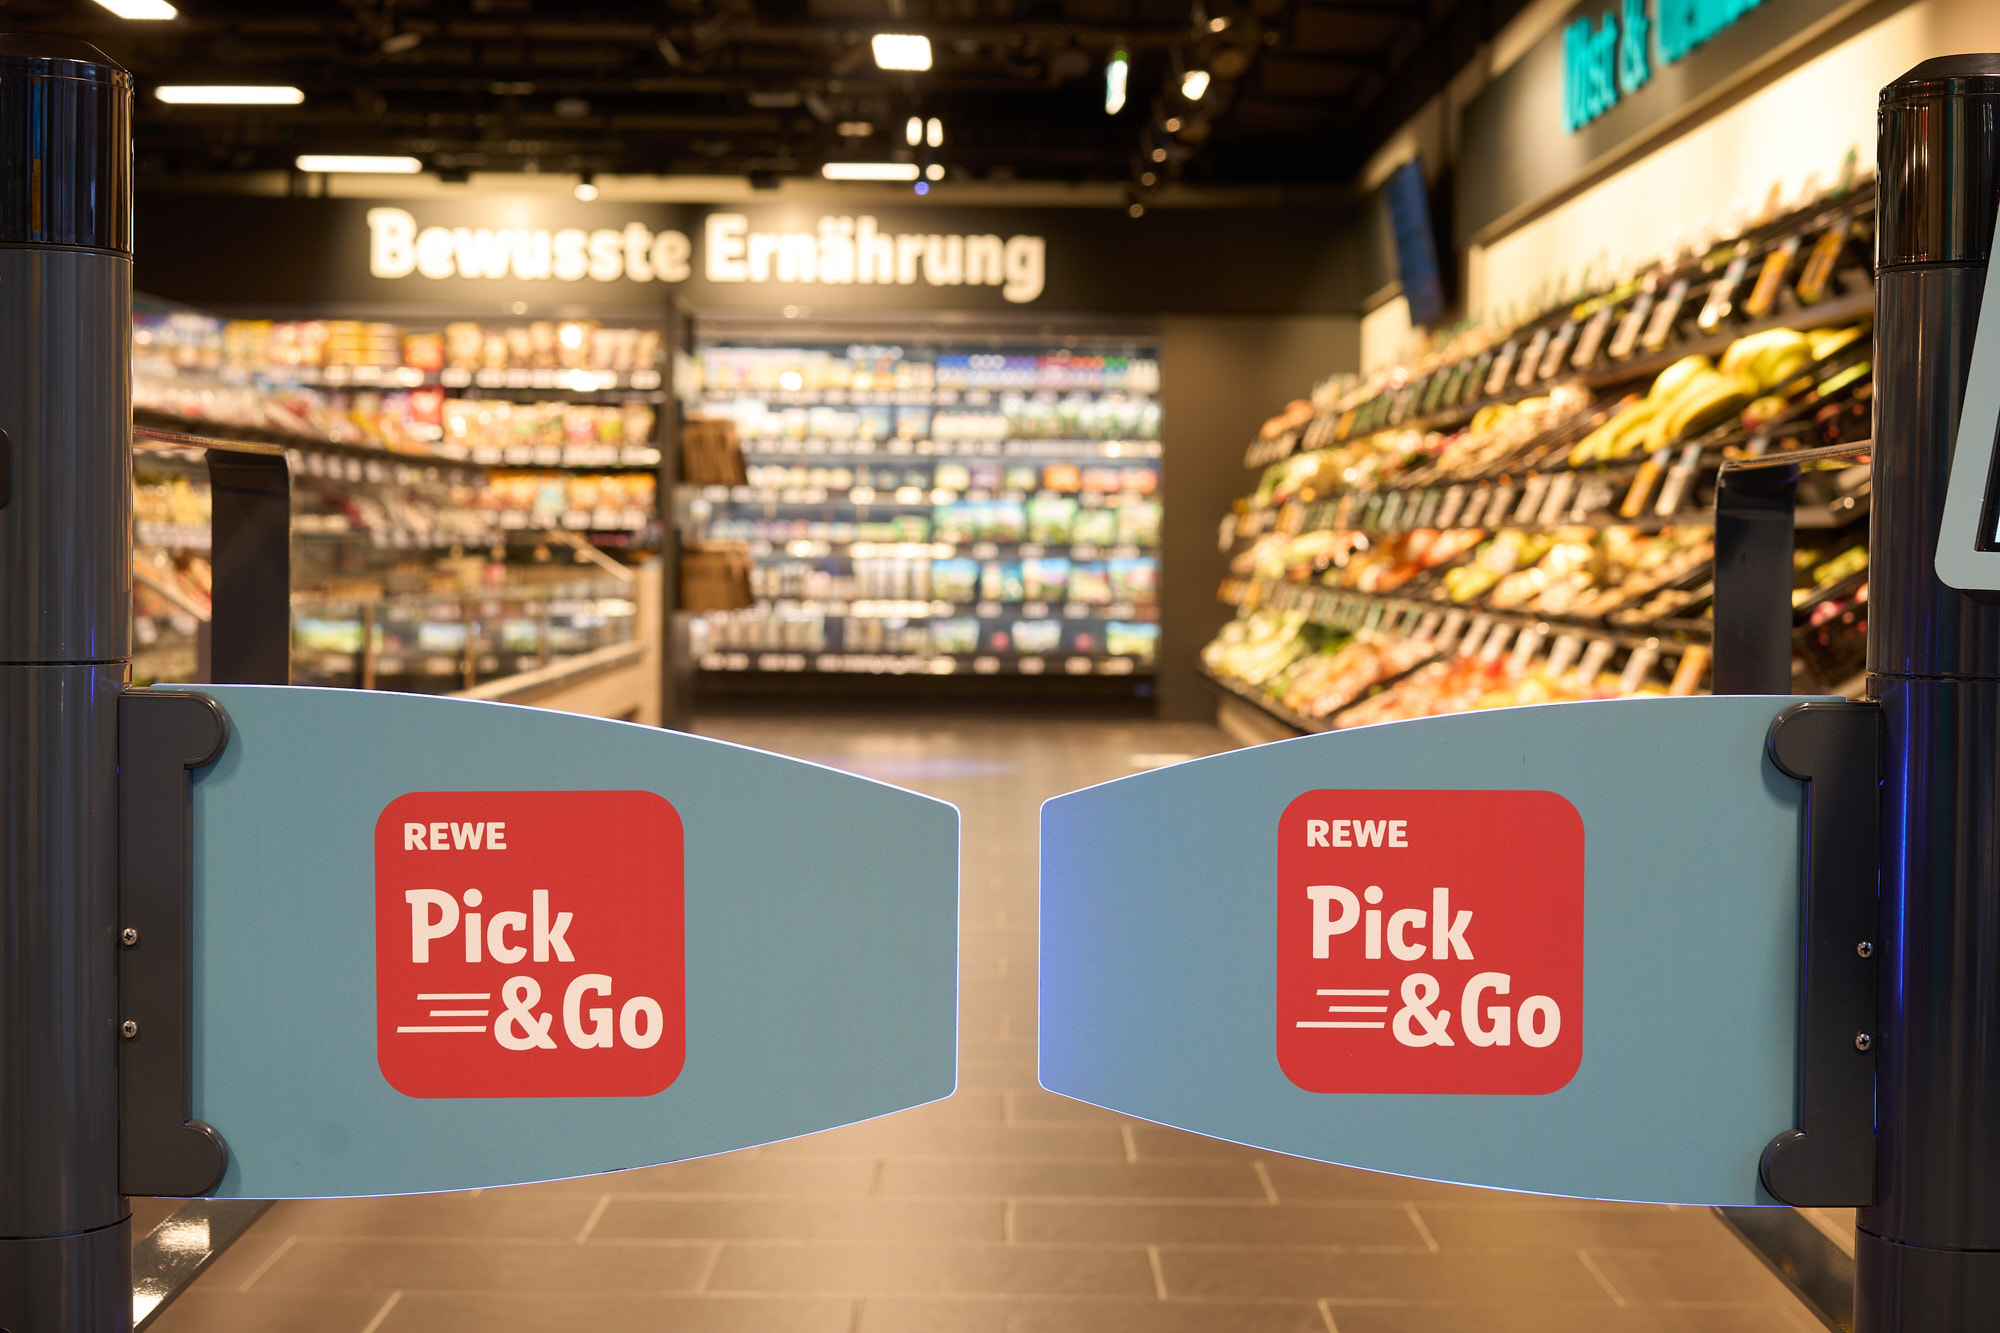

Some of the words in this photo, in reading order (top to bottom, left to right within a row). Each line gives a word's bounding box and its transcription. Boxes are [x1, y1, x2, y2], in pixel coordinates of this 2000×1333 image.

[367, 207, 691, 282] Bewusste
[705, 213, 1046, 303] Ernährung
[404, 822, 507, 850] REWE
[1306, 819, 1408, 848] REWE
[405, 888, 576, 964] Pick
[1306, 885, 1475, 962] Pick
